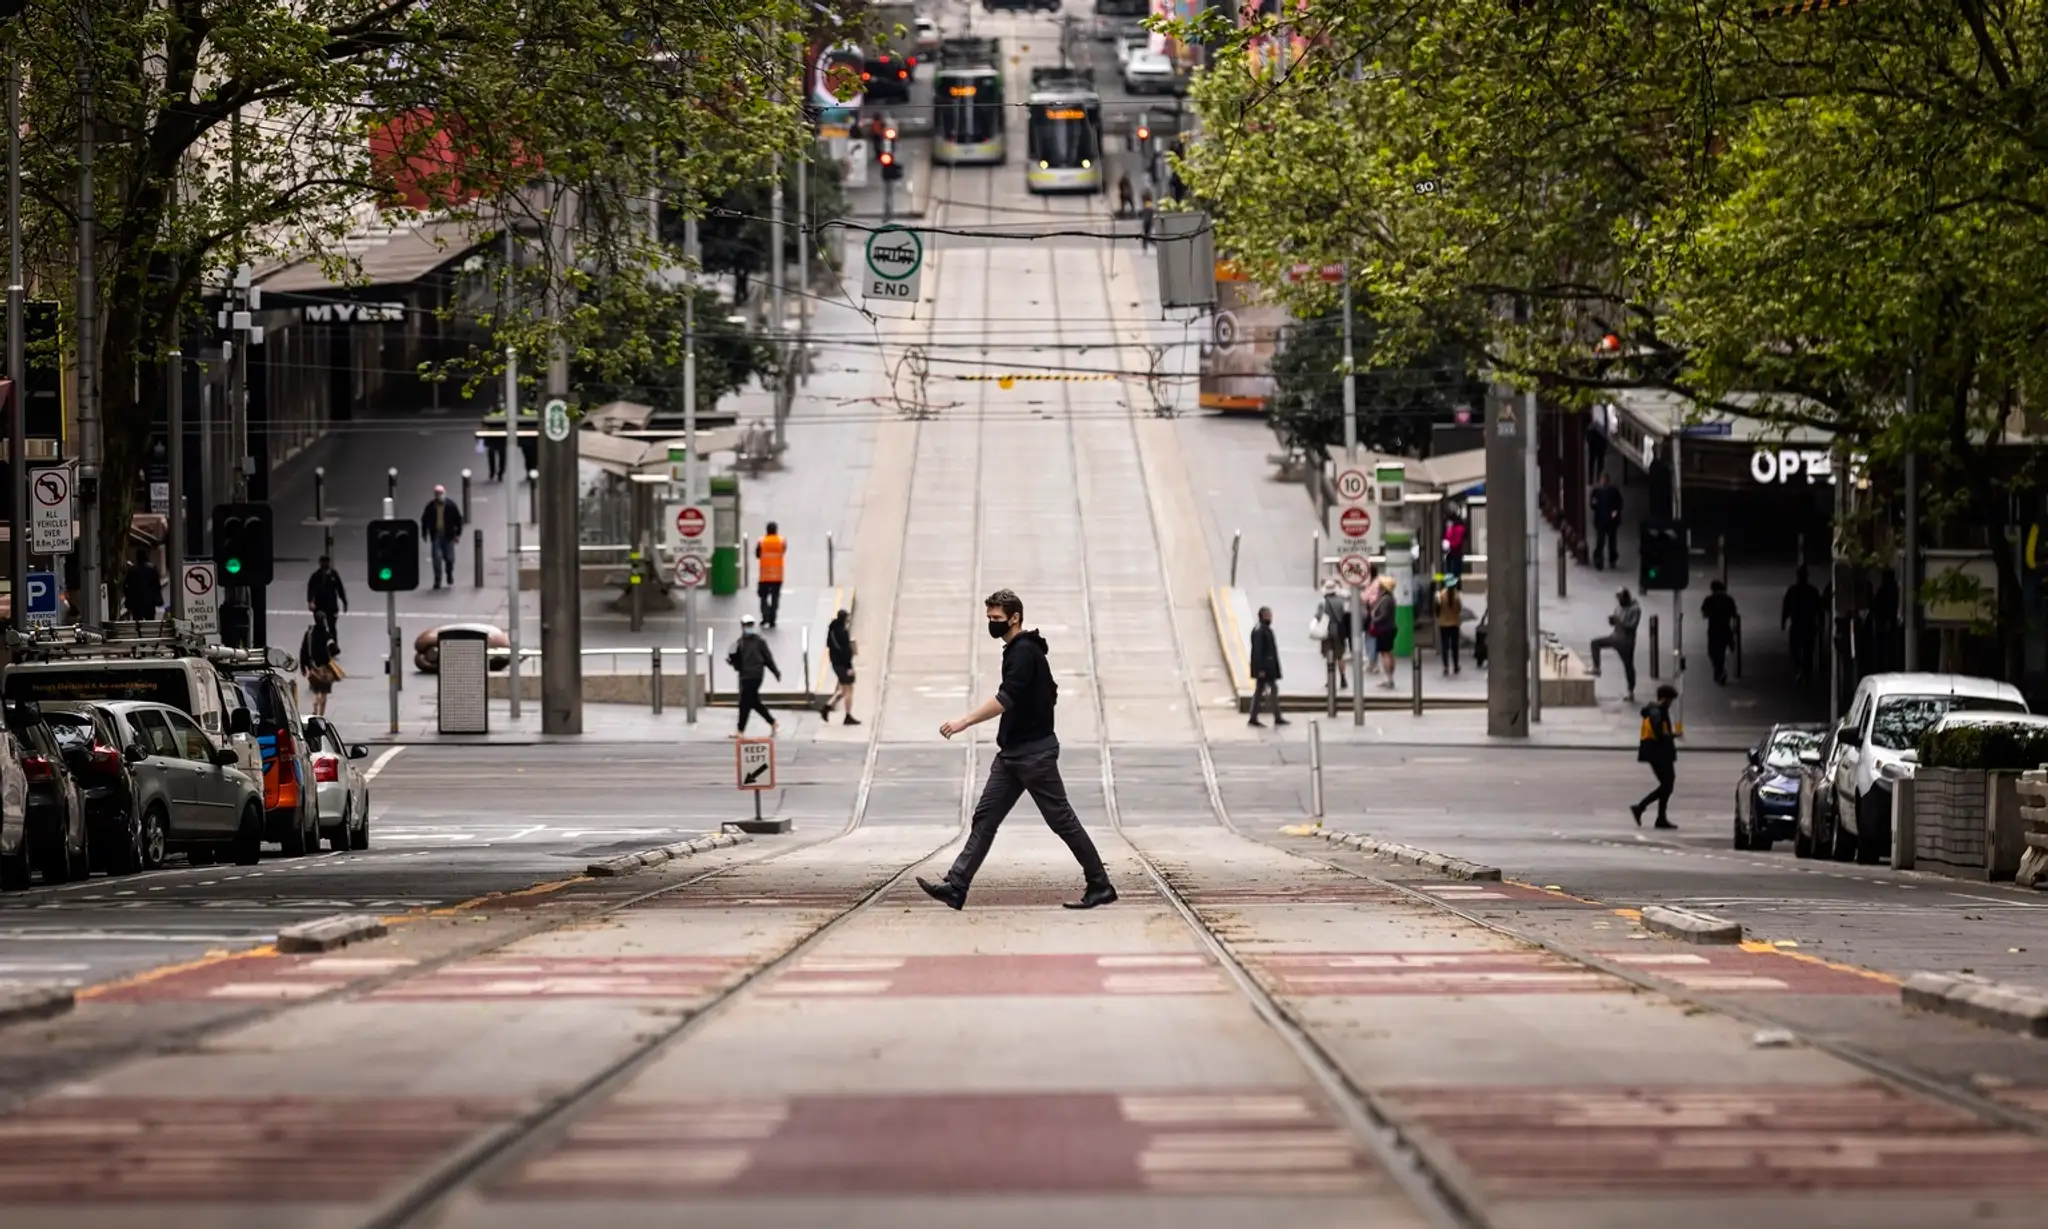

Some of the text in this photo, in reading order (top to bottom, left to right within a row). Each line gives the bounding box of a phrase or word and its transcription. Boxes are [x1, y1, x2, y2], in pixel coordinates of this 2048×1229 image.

[1415, 182, 1434, 194] 30
[873, 281, 910, 297] END
[306, 302, 404, 321] MYER
[1344, 478, 1361, 493] 10
[37, 520, 68, 528] VEHICLES
[44, 529, 61, 537] OVER
[52, 538, 70, 547] LONG
[27, 581, 47, 607] P
[187, 606, 214, 614] VEHICLES
[194, 614, 208, 622] OVER
[744, 745, 767, 753] KEEP
[745, 754, 766, 763] LEFT
